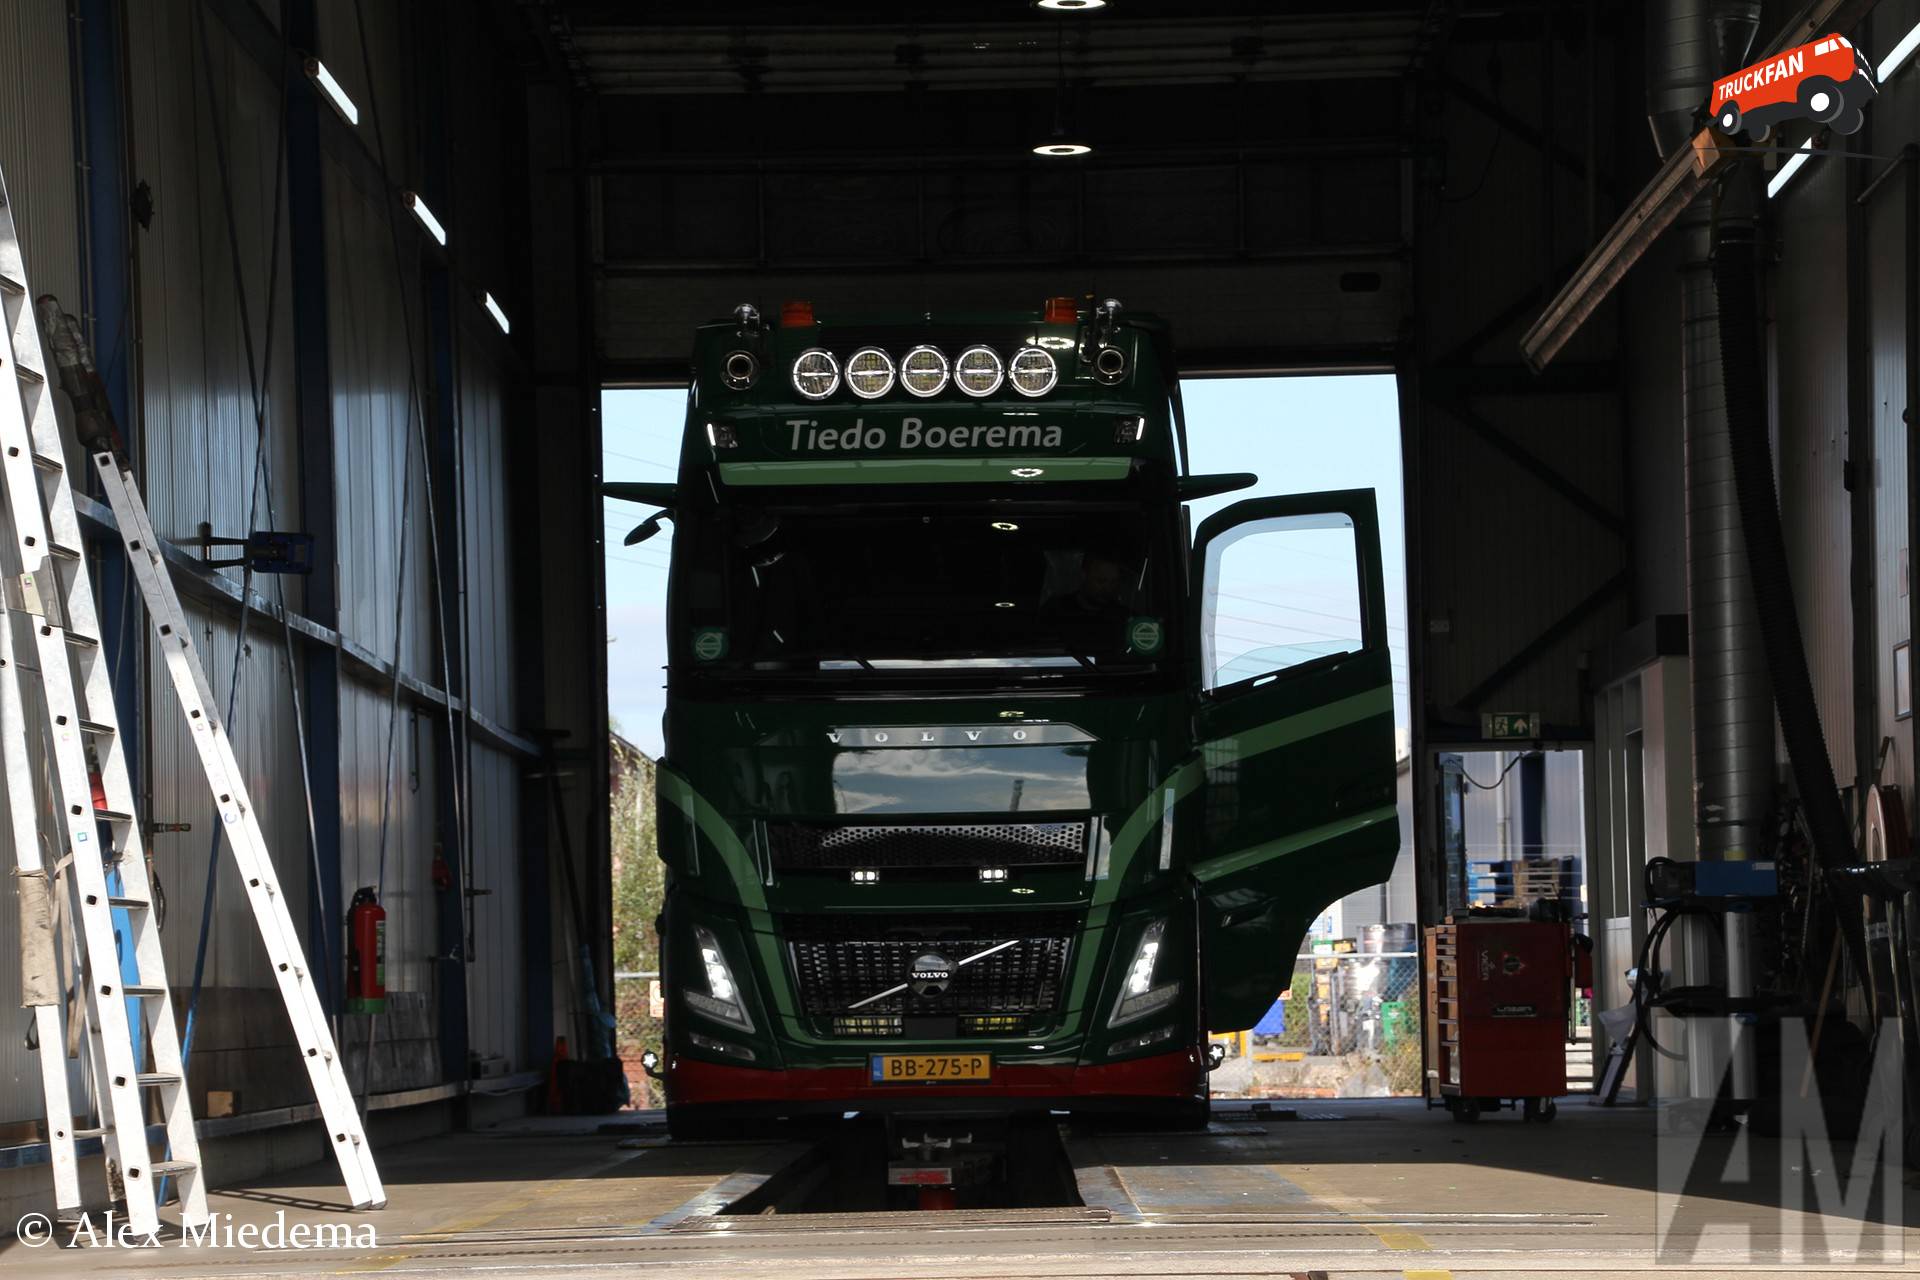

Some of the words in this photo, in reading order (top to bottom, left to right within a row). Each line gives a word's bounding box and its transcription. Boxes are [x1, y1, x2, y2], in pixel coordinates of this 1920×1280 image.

[785, 418, 887, 451] Tiedo
[899, 417, 1063, 449] Boerema
[826, 729, 1027, 744] VOLVO
[911, 971, 949, 979] VOLVO
[890, 1058, 983, 1077] BB-275-P
